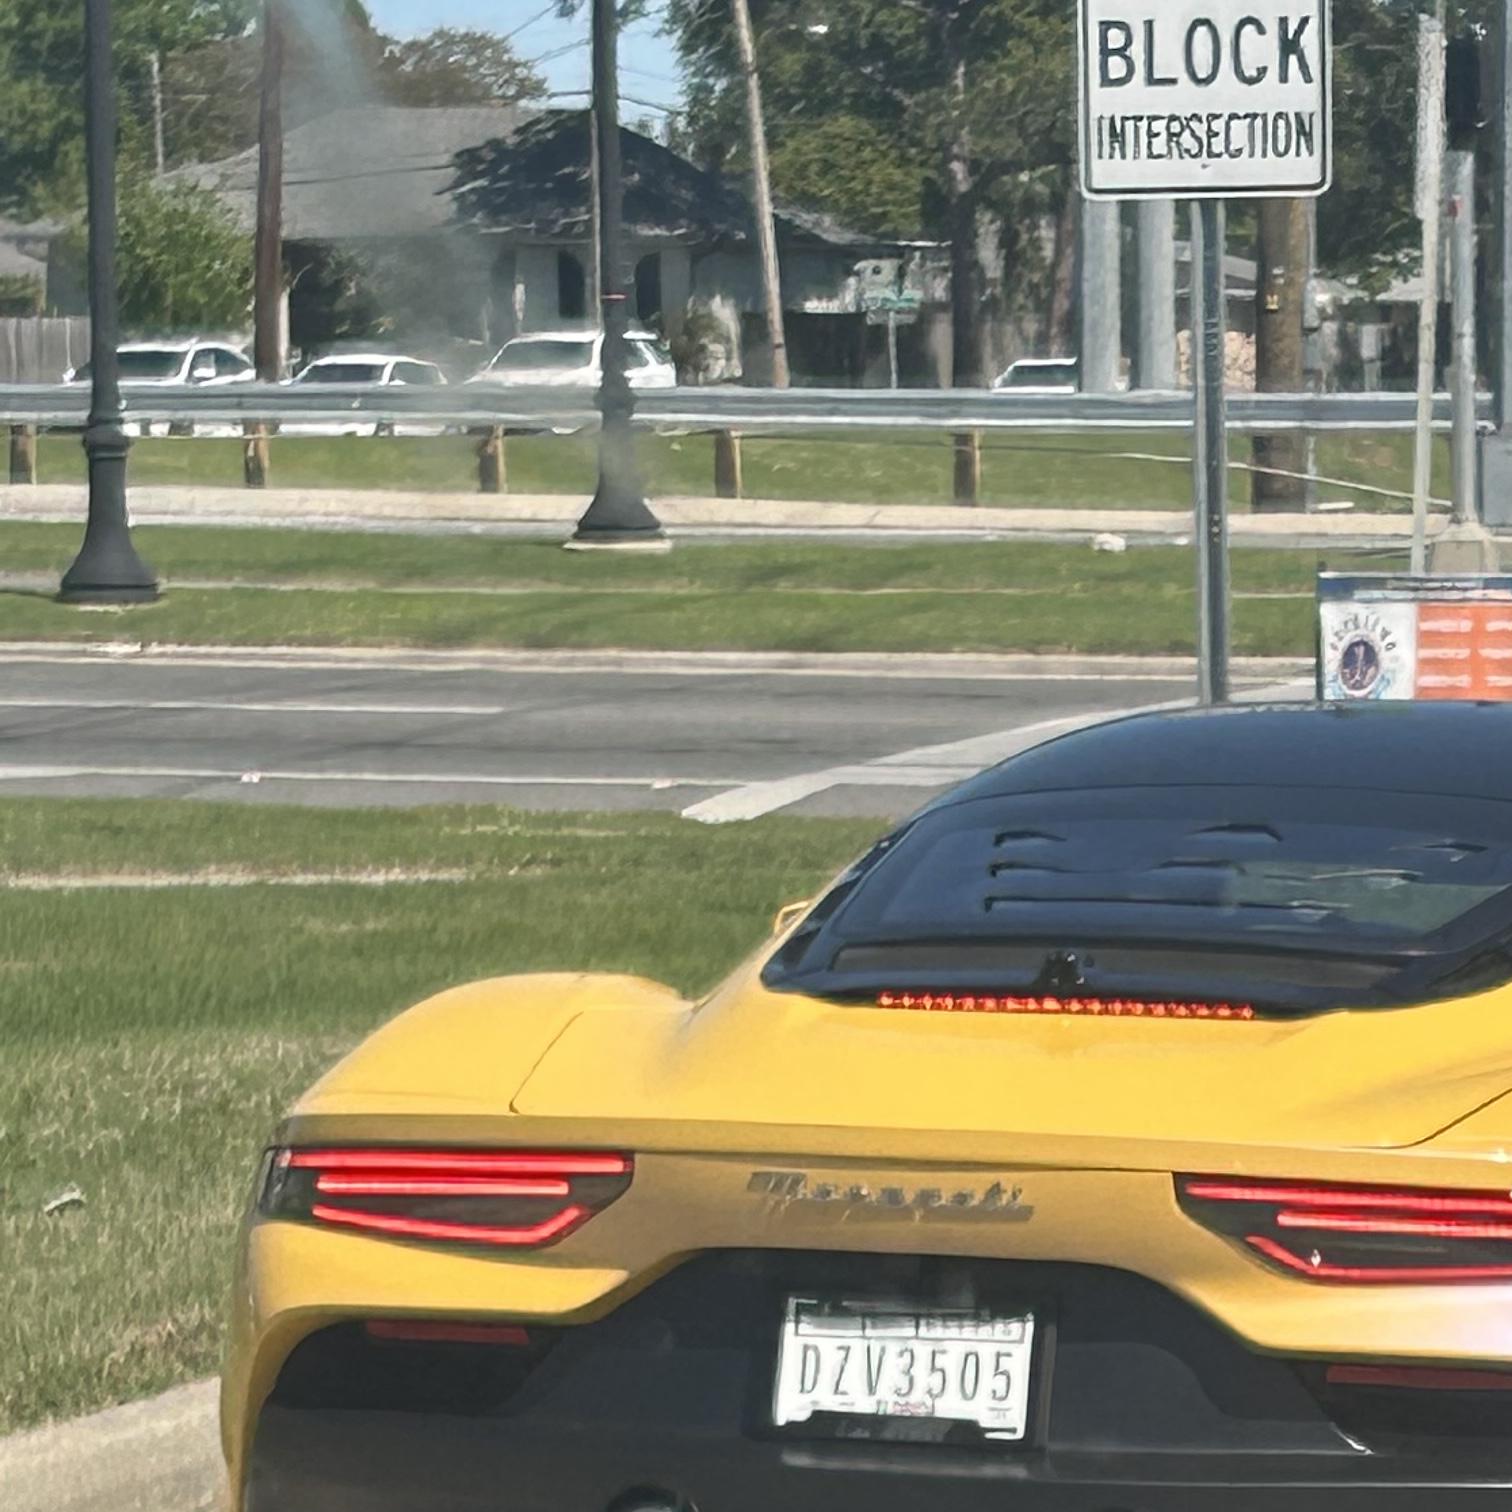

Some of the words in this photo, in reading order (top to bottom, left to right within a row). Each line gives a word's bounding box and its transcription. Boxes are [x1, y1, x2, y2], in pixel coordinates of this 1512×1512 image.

[1098, 15, 1314, 88] BLOCK
[1097, 111, 1316, 160] INTERSECTION
[799, 1343, 1013, 1402] DZV3505
